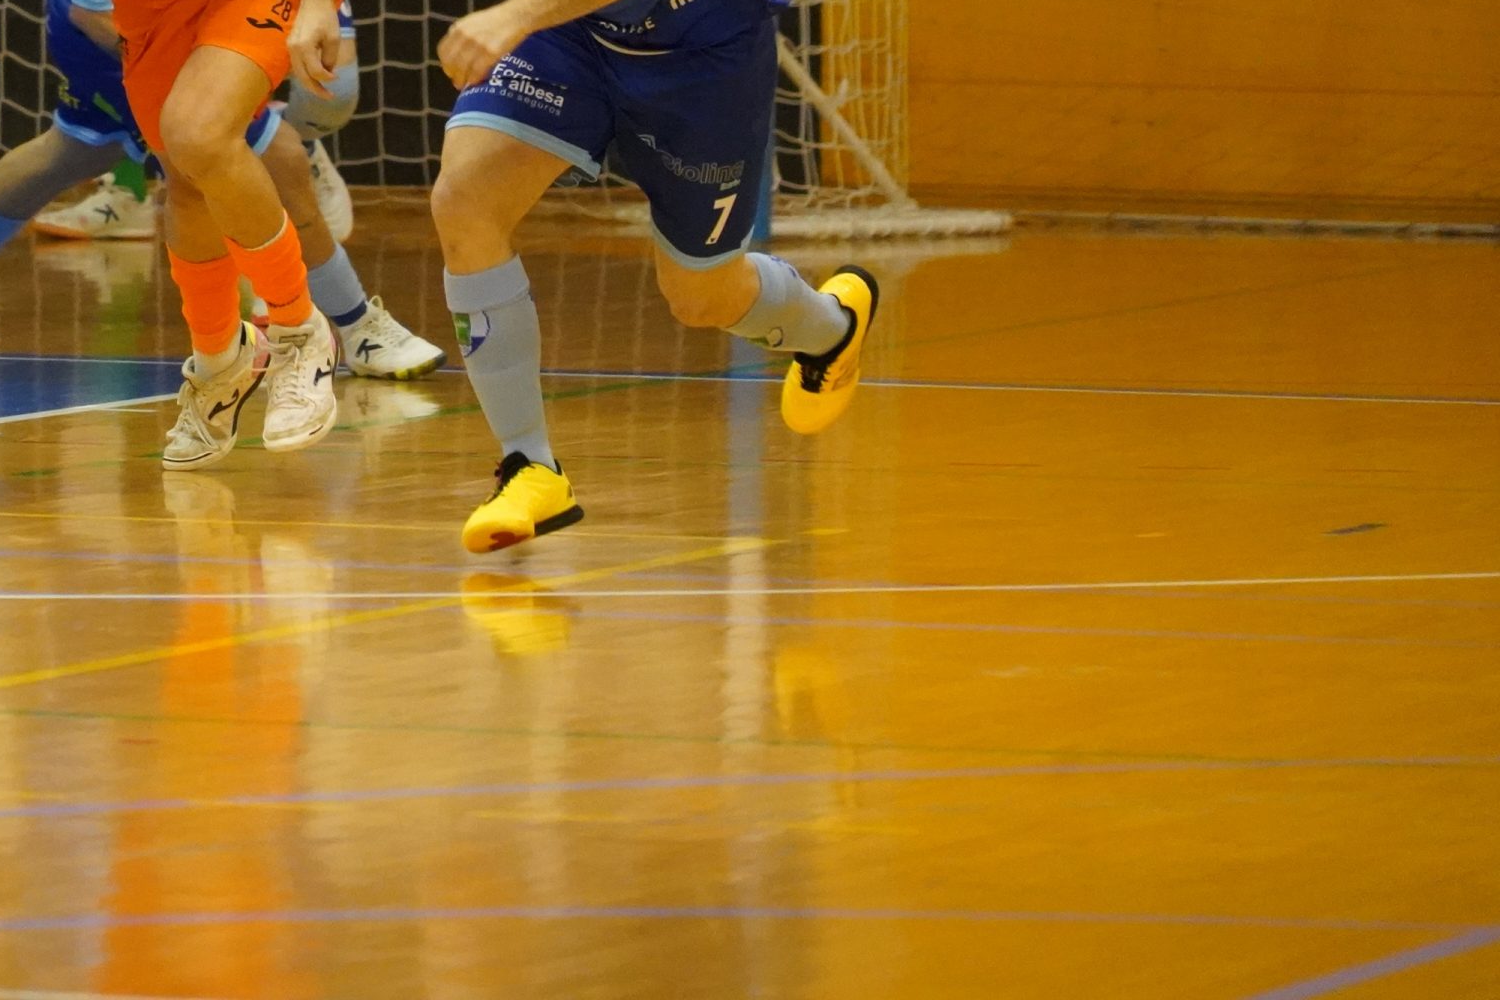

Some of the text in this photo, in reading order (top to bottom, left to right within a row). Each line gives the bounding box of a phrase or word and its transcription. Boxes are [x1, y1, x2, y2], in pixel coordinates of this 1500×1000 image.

[501, 53, 535, 72] Grupo
[508, 79, 565, 108] albesa
[705, 193, 739, 246] 7
